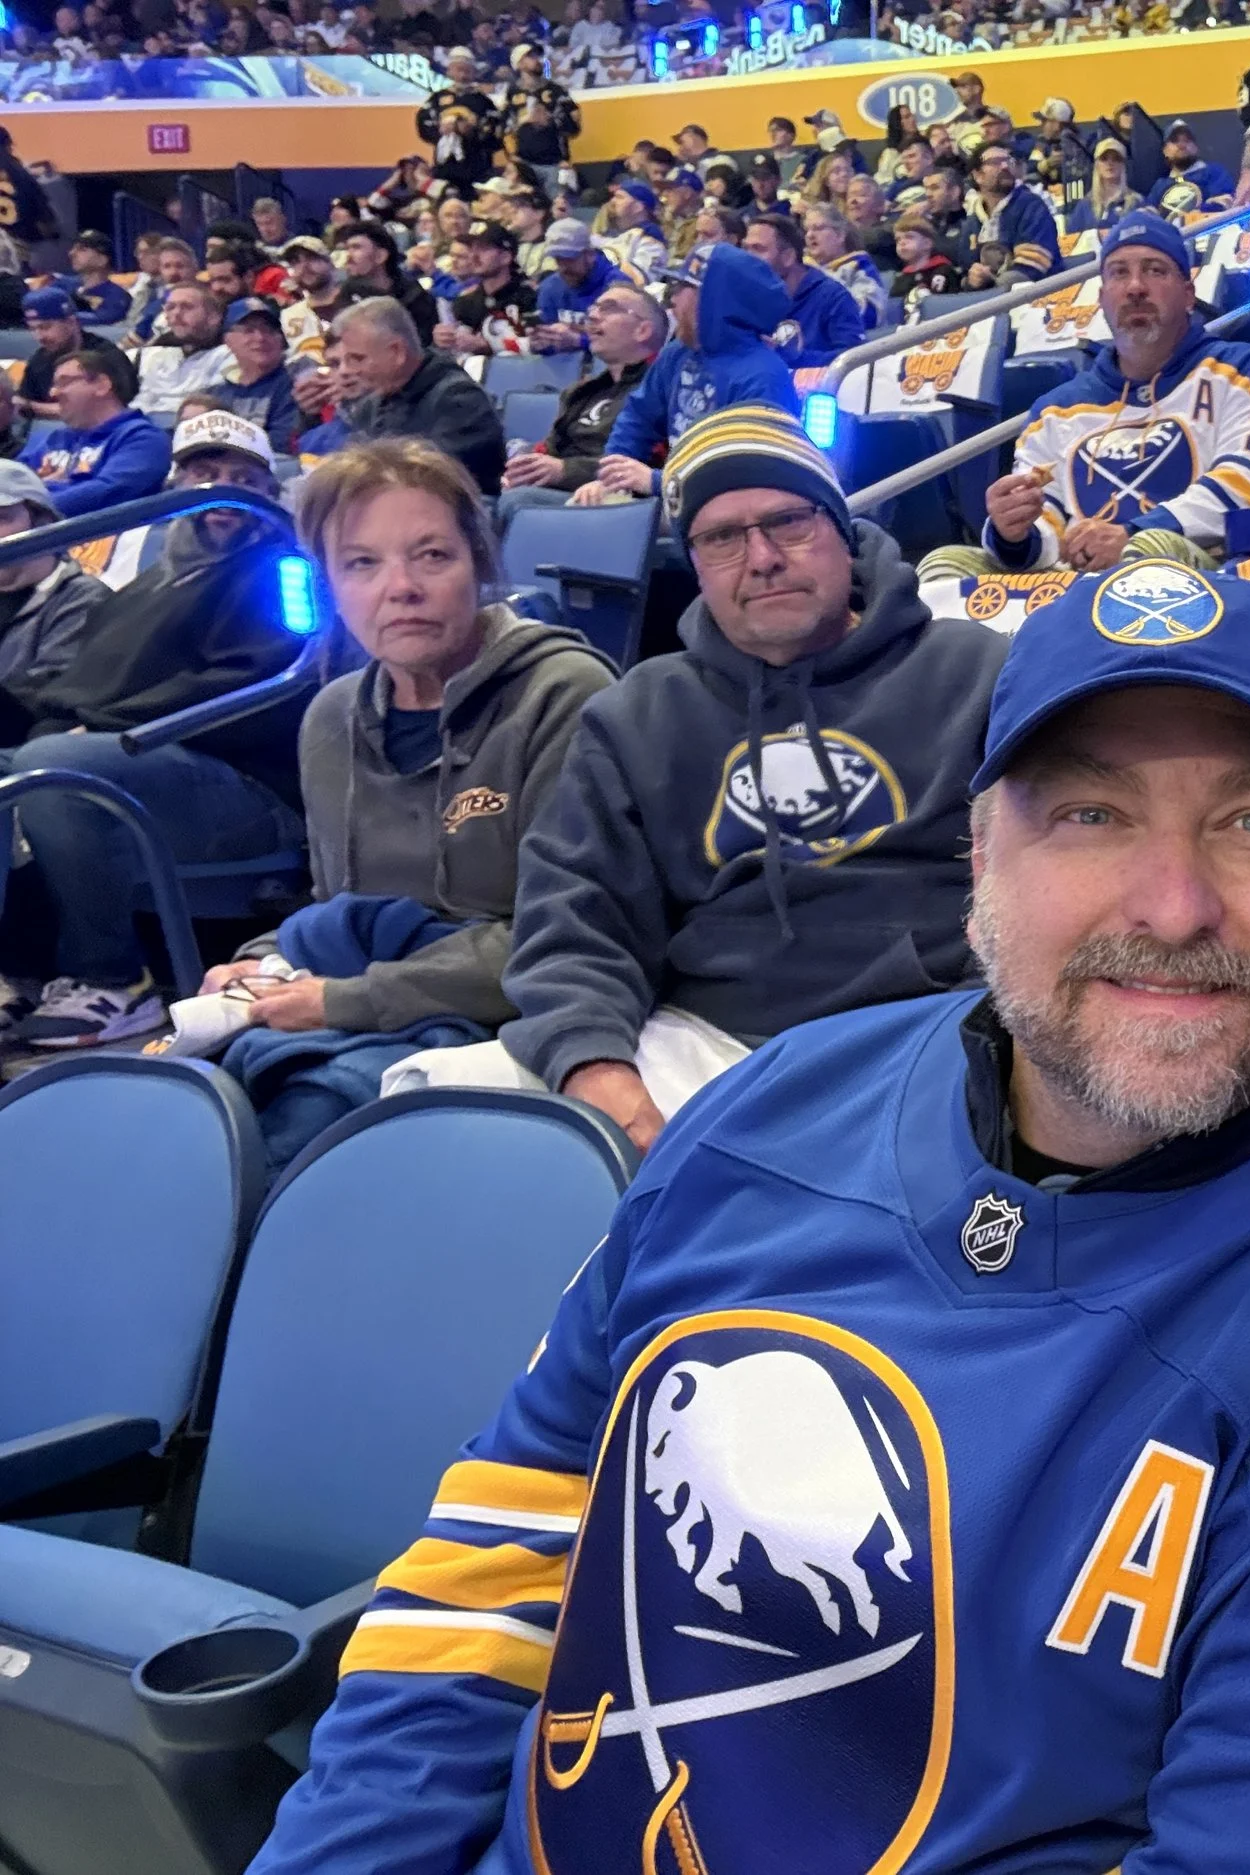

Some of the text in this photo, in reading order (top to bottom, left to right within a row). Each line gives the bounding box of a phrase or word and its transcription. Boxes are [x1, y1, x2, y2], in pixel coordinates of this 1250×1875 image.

[152, 127, 184, 149] EXIT
[1191, 377, 1215, 425] A
[971, 1222, 1007, 1249] NHL
[1044, 1438, 1215, 1680] A
